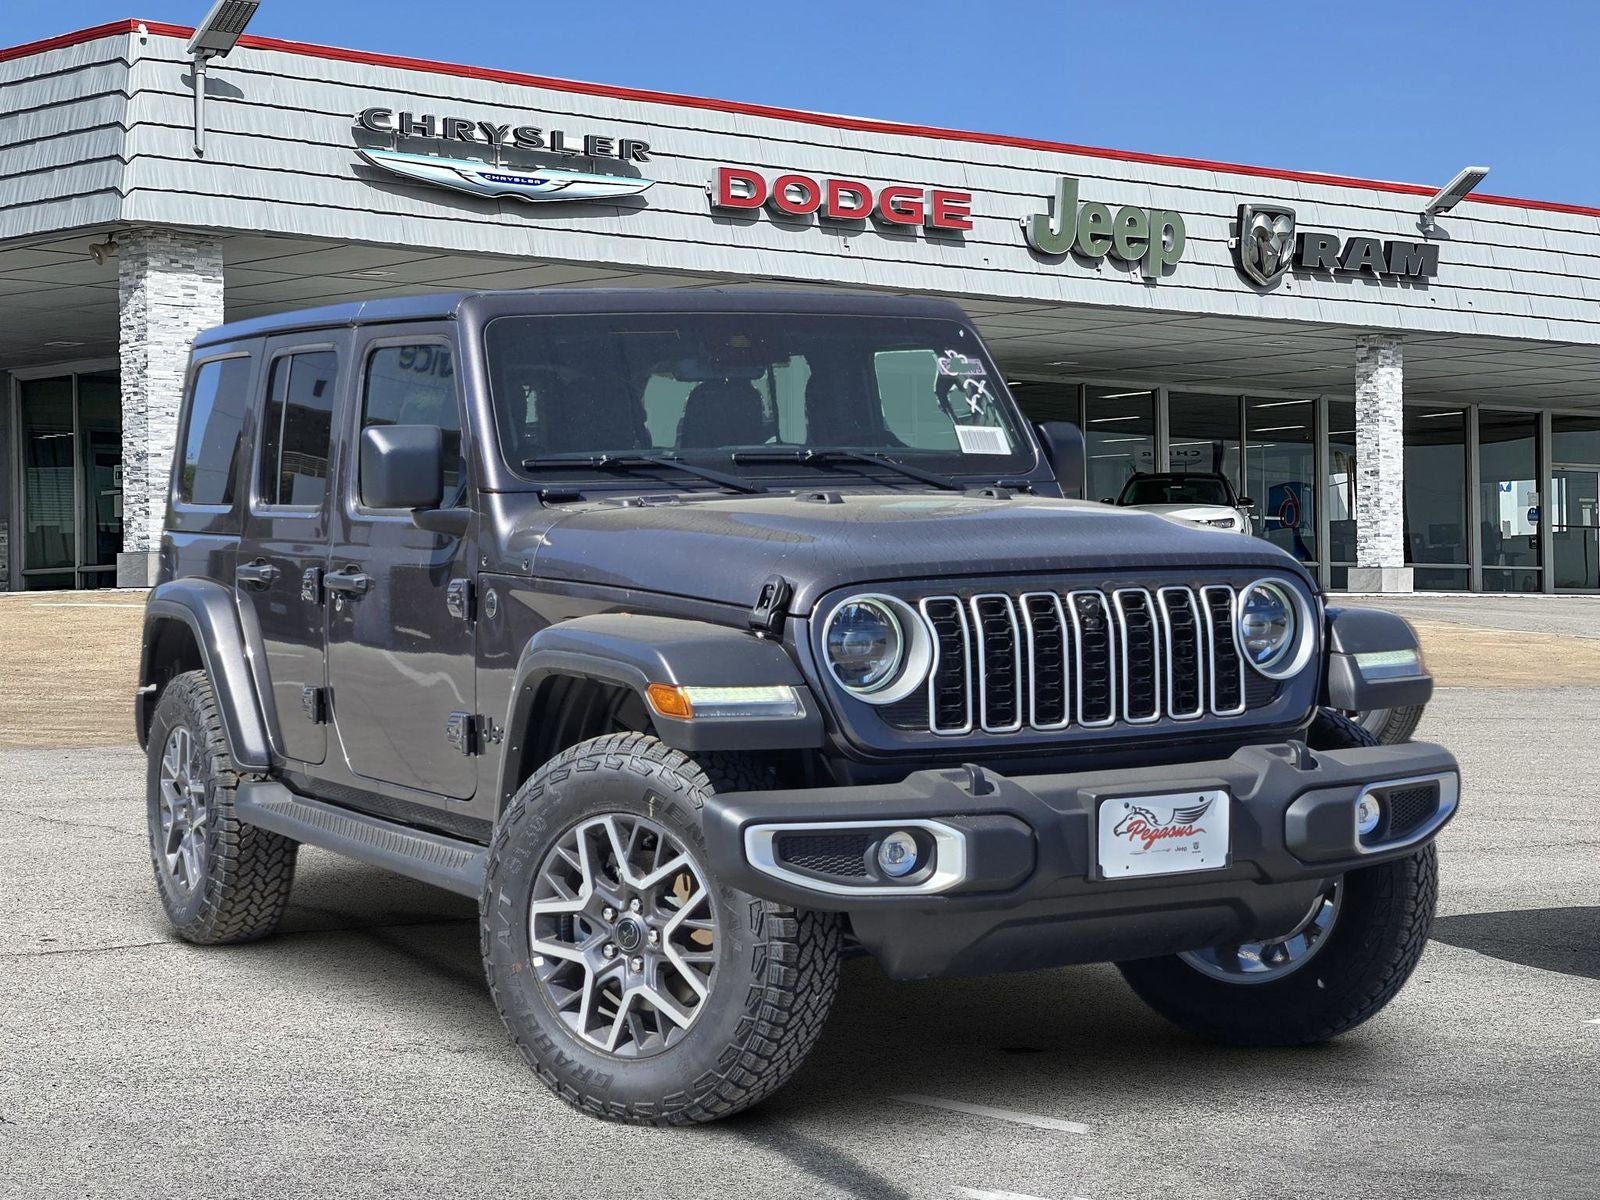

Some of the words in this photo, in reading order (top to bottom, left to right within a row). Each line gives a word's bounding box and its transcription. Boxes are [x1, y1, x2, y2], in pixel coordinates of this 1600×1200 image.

[359, 106, 651, 163] CHRYSLER
[484, 173, 542, 185] CHRYSLER
[712, 166, 974, 231] DODGE
[1029, 176, 1186, 278] Jeep
[1296, 232, 1440, 277] RAM
[1126, 819, 1207, 851] Pegasus
